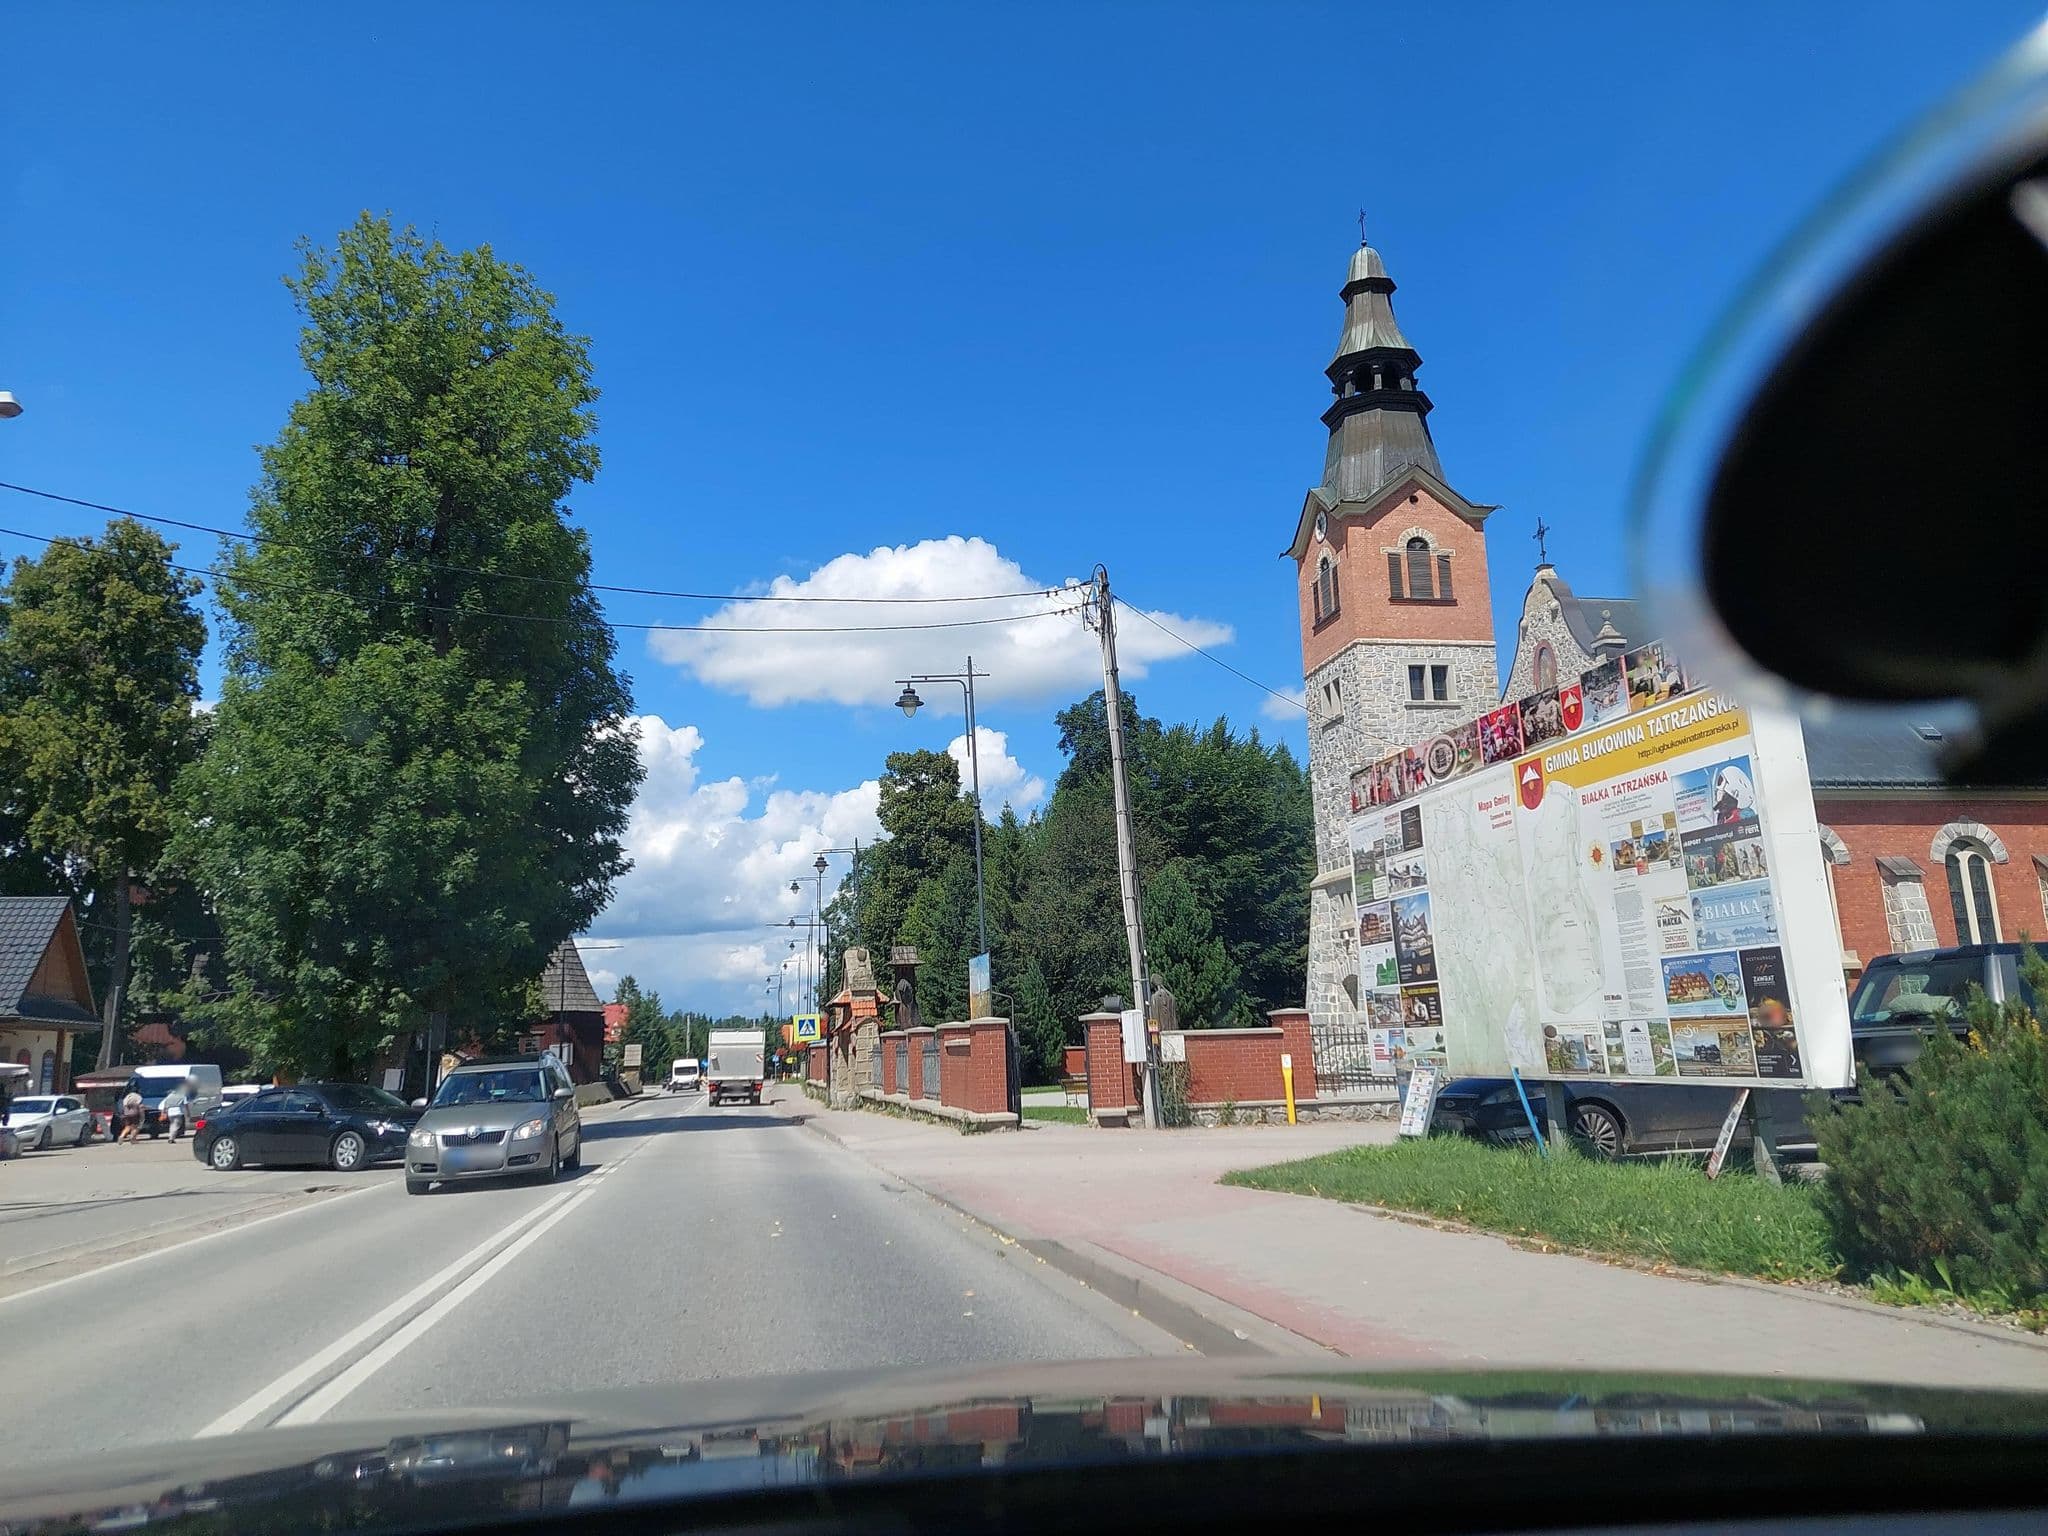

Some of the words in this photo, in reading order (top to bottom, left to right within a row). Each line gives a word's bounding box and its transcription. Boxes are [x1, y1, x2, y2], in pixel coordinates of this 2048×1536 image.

[1545, 748, 1581, 773] GMINA
[1582, 729, 1645, 762] BUKOWINA
[1646, 695, 1739, 739] TATRZAŃSKA
[1581, 788, 1610, 805] BIAŁKA
[1611, 770, 1669, 797] TATRZAŃSKA
[1477, 801, 1493, 812] Mapa
[1493, 794, 1510, 806] Gminy
[1704, 900, 1761, 920] BIAŁKA
